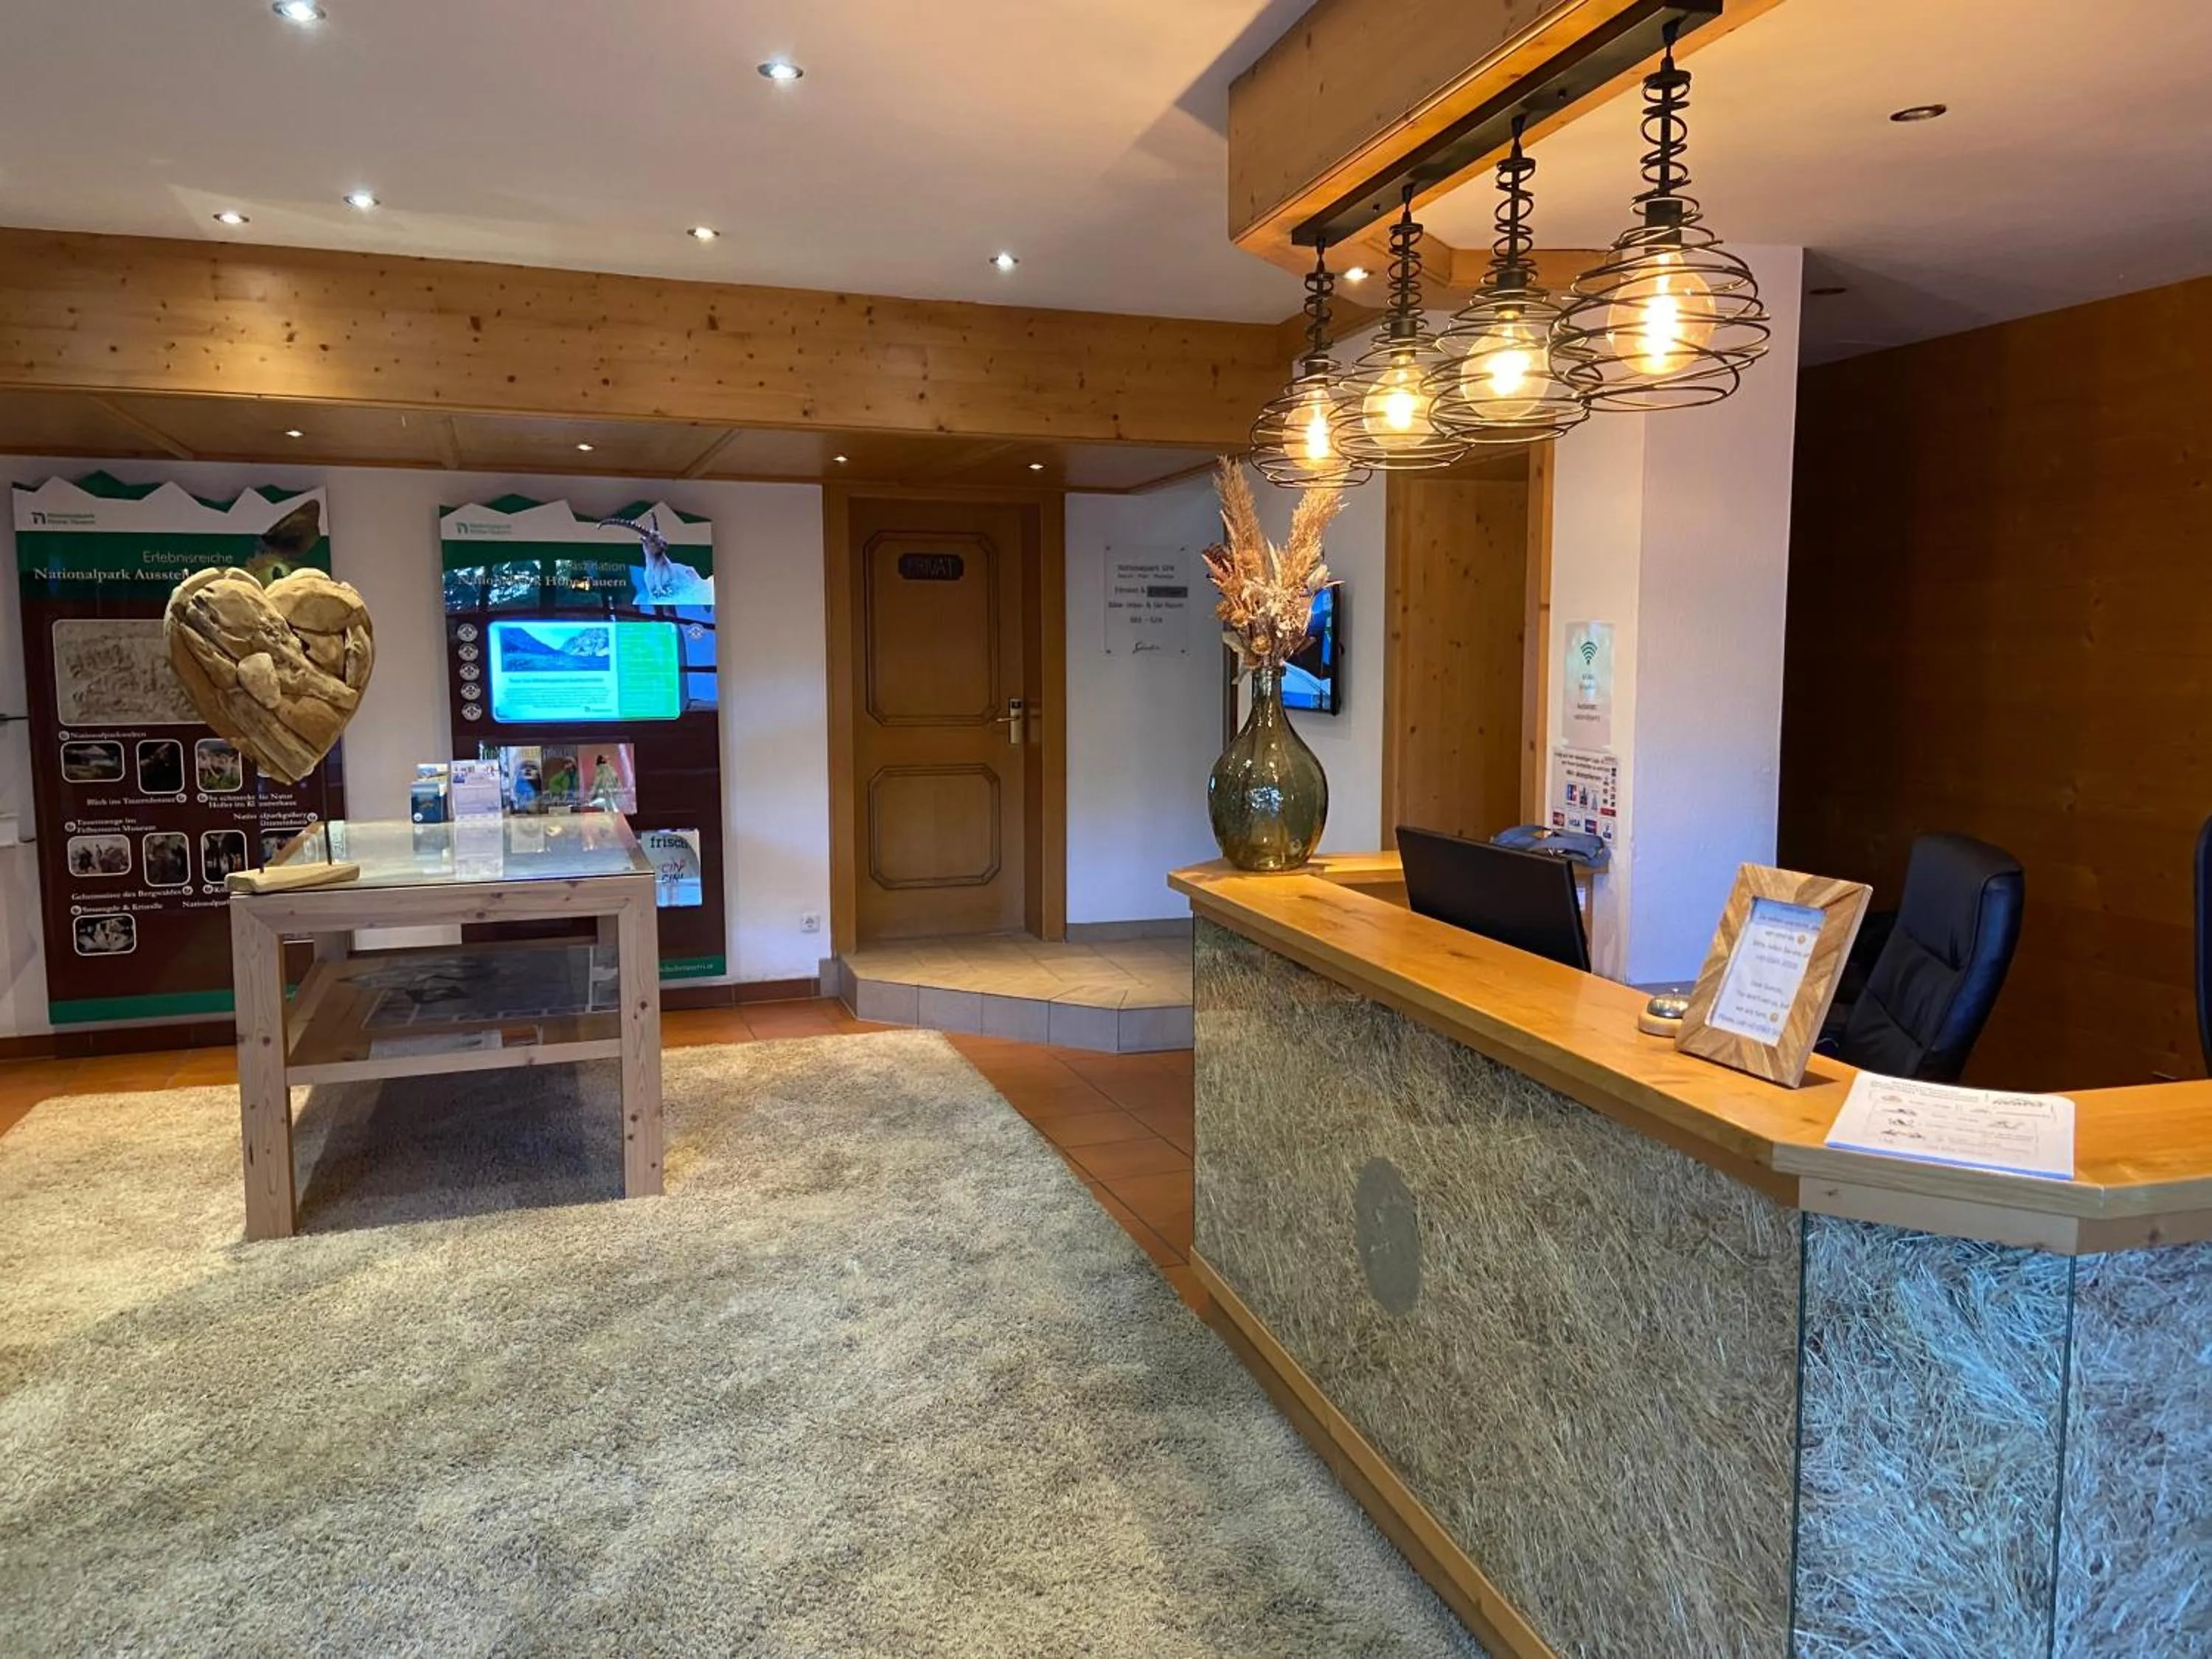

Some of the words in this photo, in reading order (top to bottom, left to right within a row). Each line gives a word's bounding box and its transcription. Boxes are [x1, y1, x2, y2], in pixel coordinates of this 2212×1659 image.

[142, 550, 234, 564] Erlebnisreiche
[568, 561, 626, 571] asznation
[34, 567, 131, 583] Nationalpark
[457, 574, 541, 586] Natiok
[581, 575, 626, 587] Tauern
